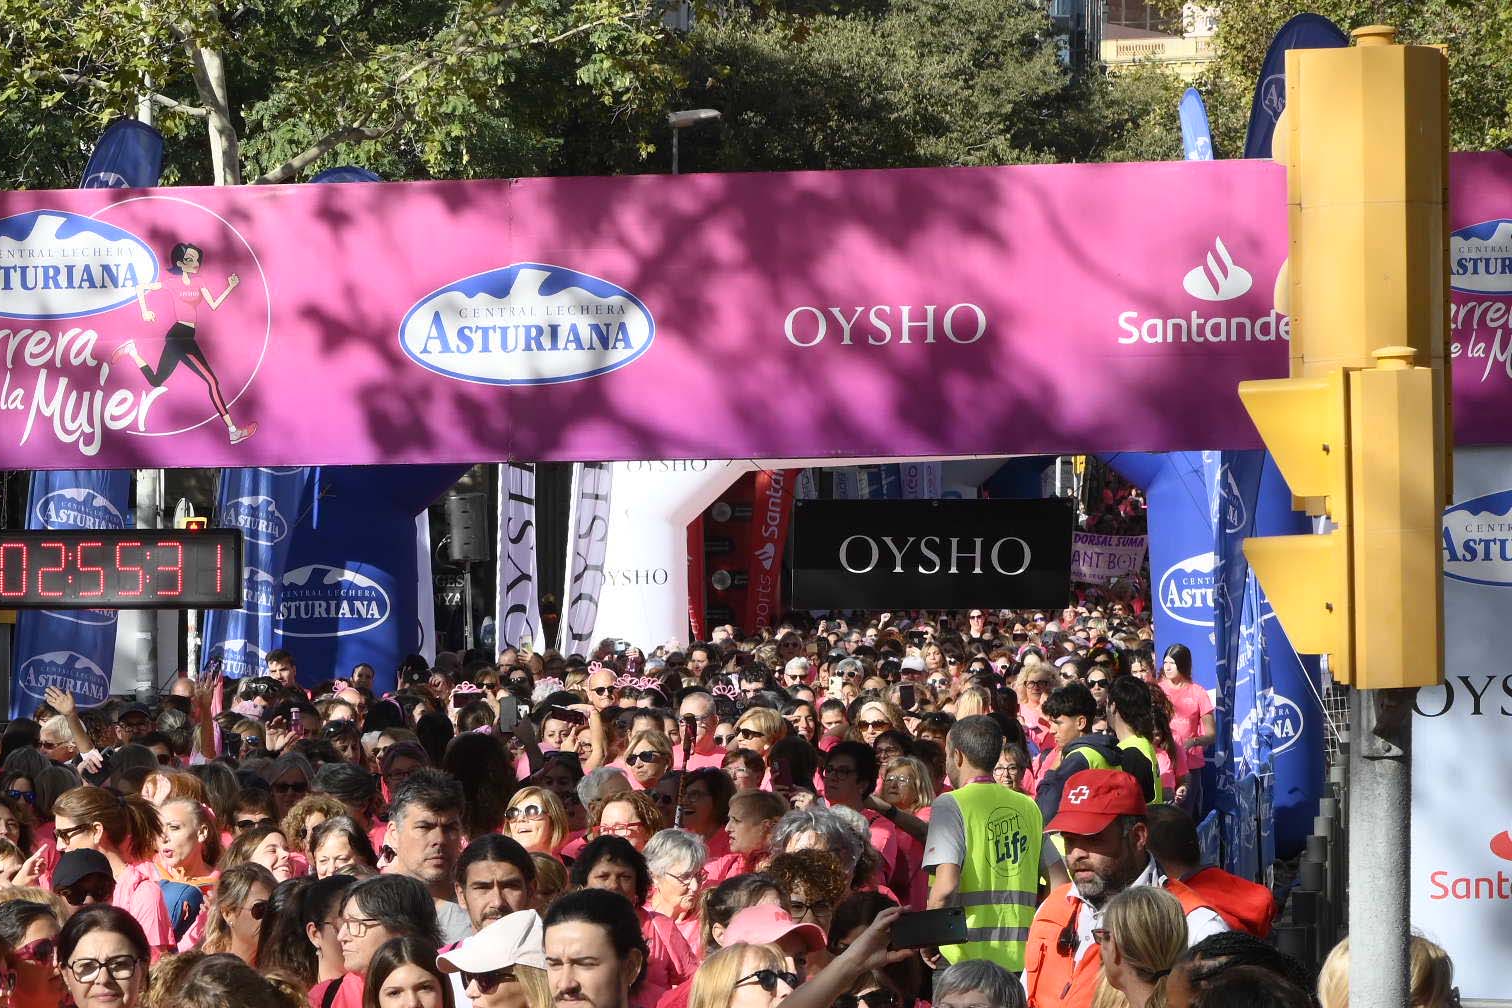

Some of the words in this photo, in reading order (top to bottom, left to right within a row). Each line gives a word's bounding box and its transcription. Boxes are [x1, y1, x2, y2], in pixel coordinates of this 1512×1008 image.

[61, 246, 138, 258] LECHERA
[459, 303, 538, 318] CENTRAL
[545, 302, 627, 317] LECHERA
[784, 303, 987, 347] OYSHO
[419, 310, 635, 355] ASTURIANA
[1118, 310, 1291, 345] Santande
[0, 369, 25, 411] la
[19, 361, 169, 456] Mujer
[838, 534, 1032, 576] OYSHO
[327, 588, 376, 598] LECHERA
[276, 600, 381, 620] STURIANA
[24, 668, 104, 700] ASTURIANA
[988, 813, 1020, 842] Sport
[994, 831, 1028, 865] Life
[1430, 871, 1512, 899] Sant
